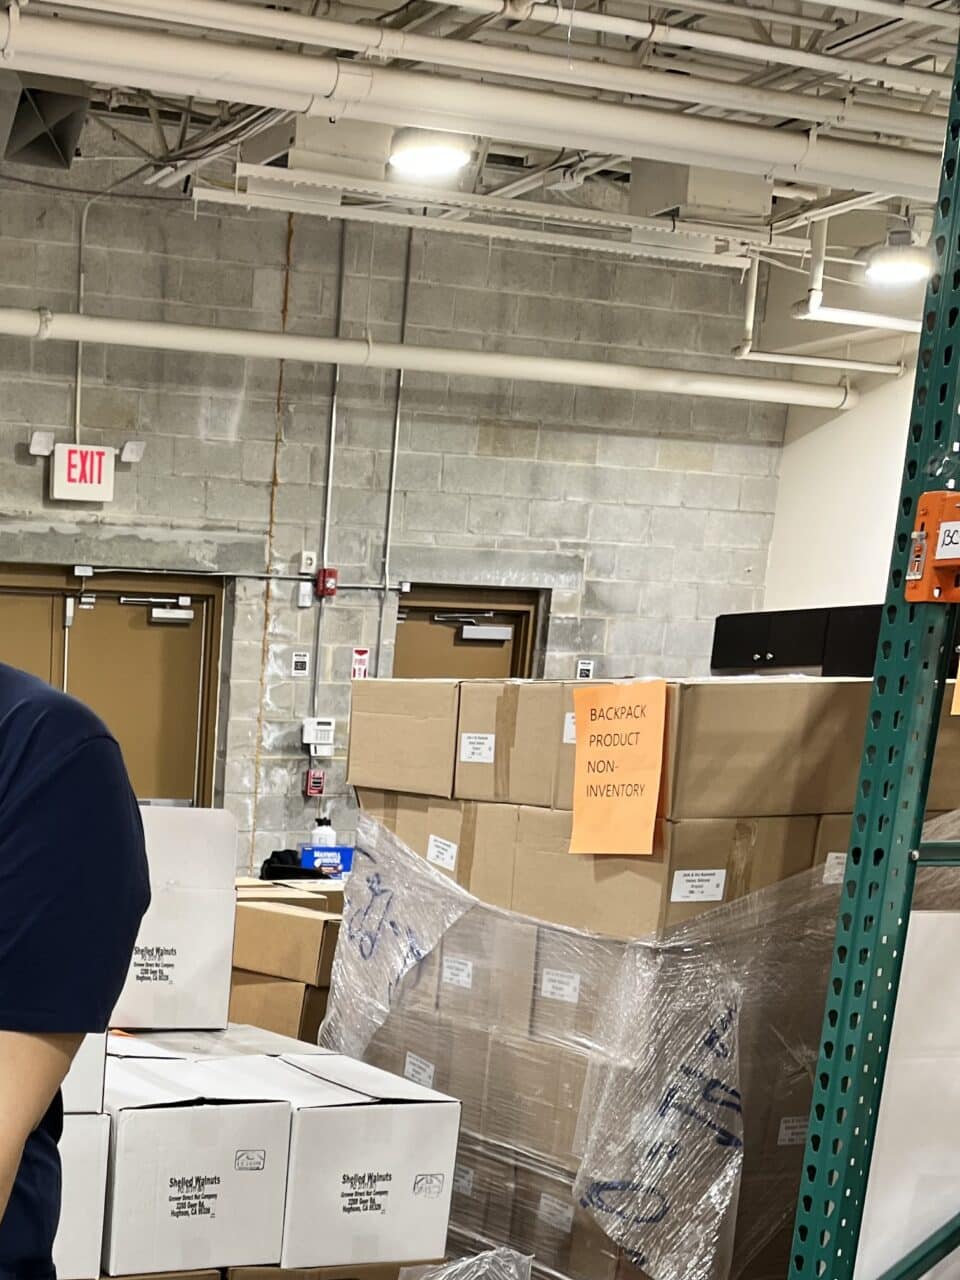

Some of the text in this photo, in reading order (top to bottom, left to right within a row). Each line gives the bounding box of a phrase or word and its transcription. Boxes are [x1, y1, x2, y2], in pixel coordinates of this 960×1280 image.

[67, 449, 106, 485] EXIT
[590, 704, 647, 722] BACKPACK
[589, 731, 641, 748] PRODUCT
[587, 760, 619, 774] NON-
[586, 783, 646, 798] INVENTORY
[169, 1175, 221, 1188] Shelled Walnuts
[342, 1172, 392, 1184] Shelled Walnuts
